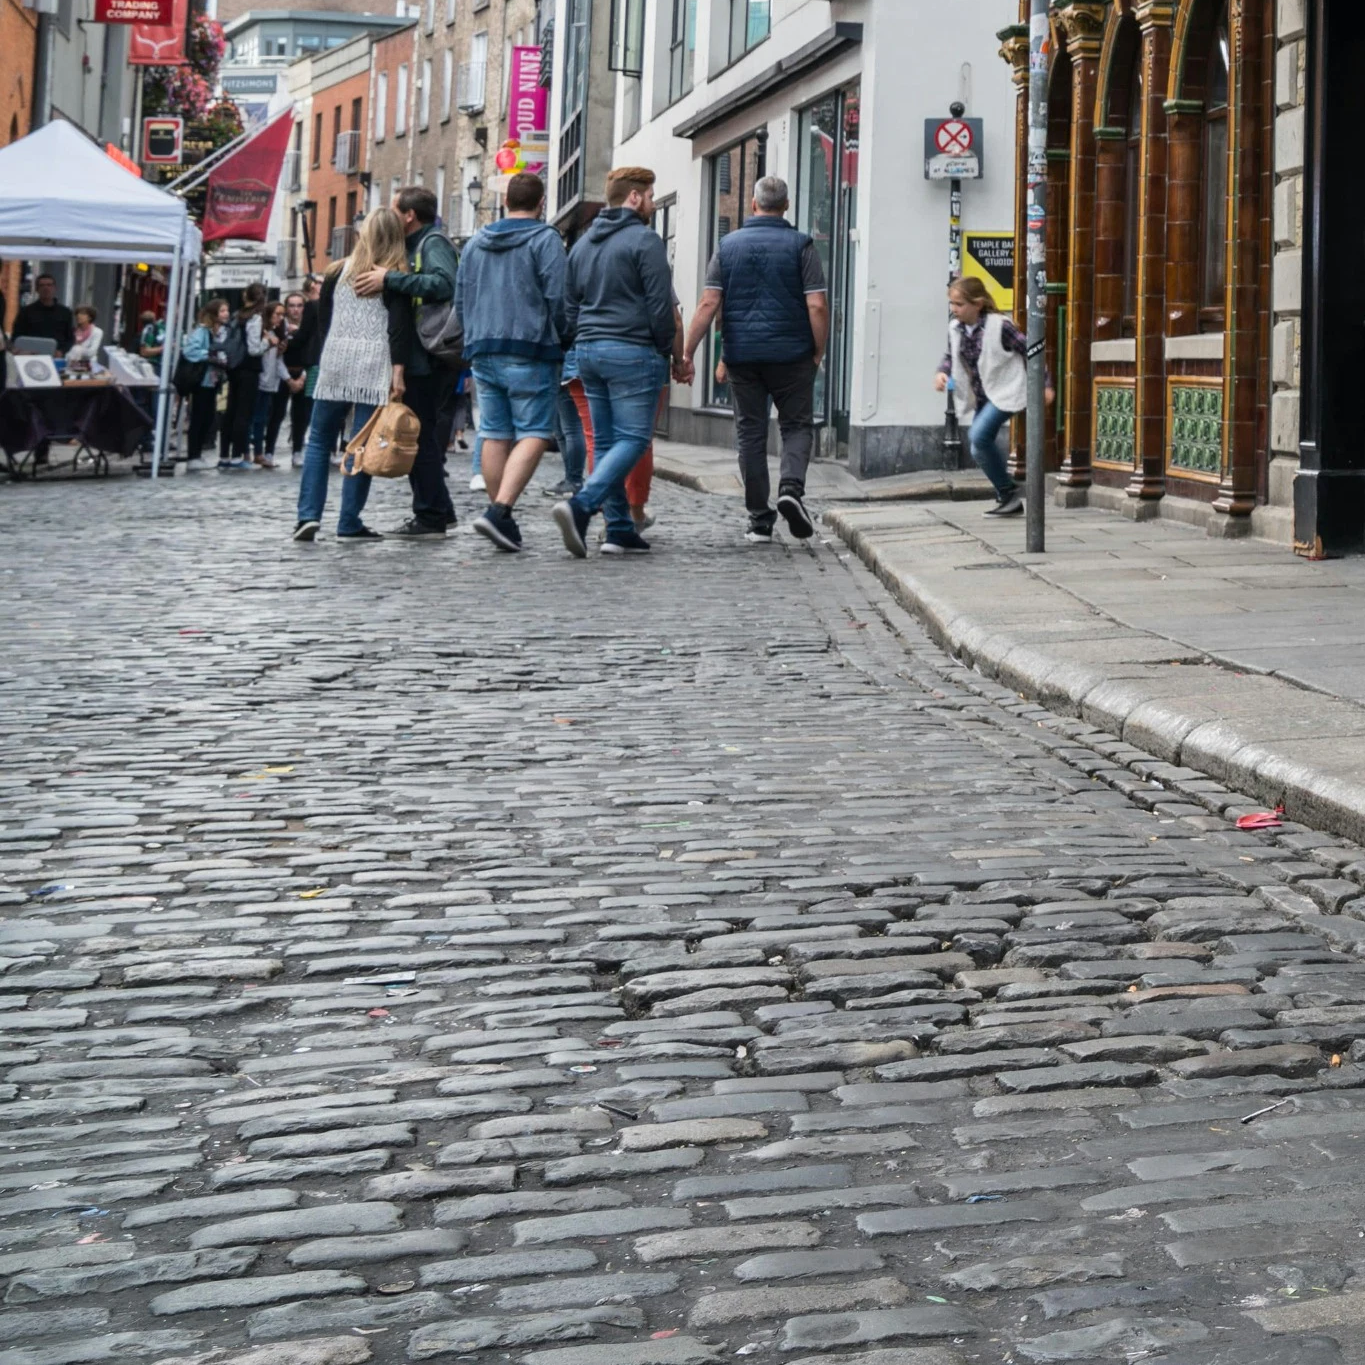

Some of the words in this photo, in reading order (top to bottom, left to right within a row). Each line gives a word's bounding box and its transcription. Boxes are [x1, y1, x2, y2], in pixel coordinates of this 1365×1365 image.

[111, 0, 159, 10] TRADING
[106, 9, 161, 20] COMPANY
[519, 50, 542, 92] NINE
[517, 98, 535, 133] OUD
[972, 240, 1000, 249] TEMPLE
[978, 250, 1009, 258] GALLERY
